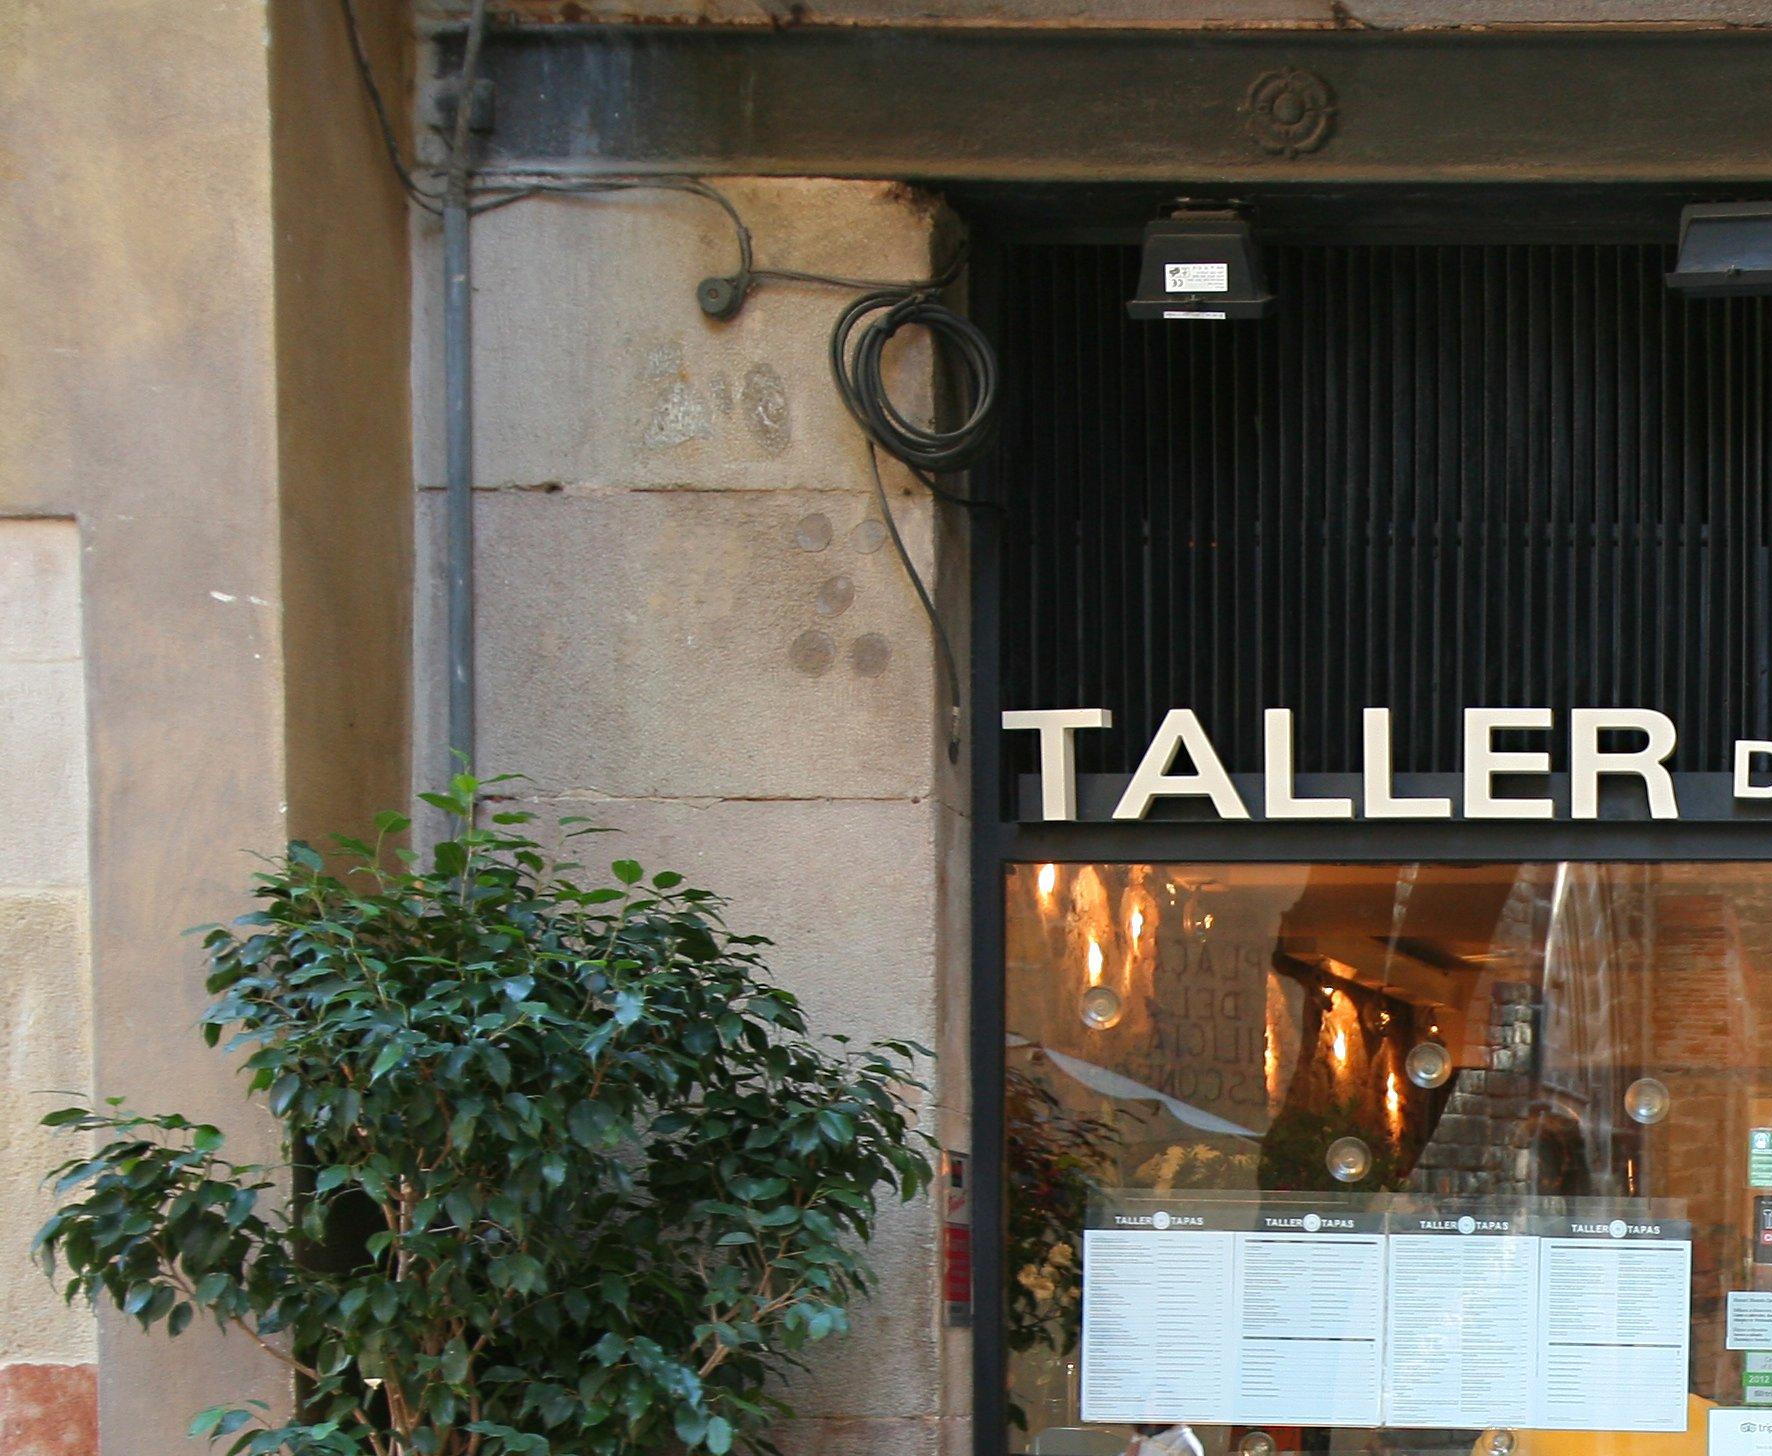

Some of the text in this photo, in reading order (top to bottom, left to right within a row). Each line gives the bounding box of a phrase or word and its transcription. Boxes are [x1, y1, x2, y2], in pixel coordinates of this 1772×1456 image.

[1002, 708, 1682, 820] TALLER
[1115, 1215, 1204, 1226] TALLER TAPAS
[1265, 1217, 1355, 1229] TALLER TAPAS
[1420, 1219, 1510, 1231] TALLER TAPAS
[1571, 1223, 1661, 1235] TALLER TAPAS
